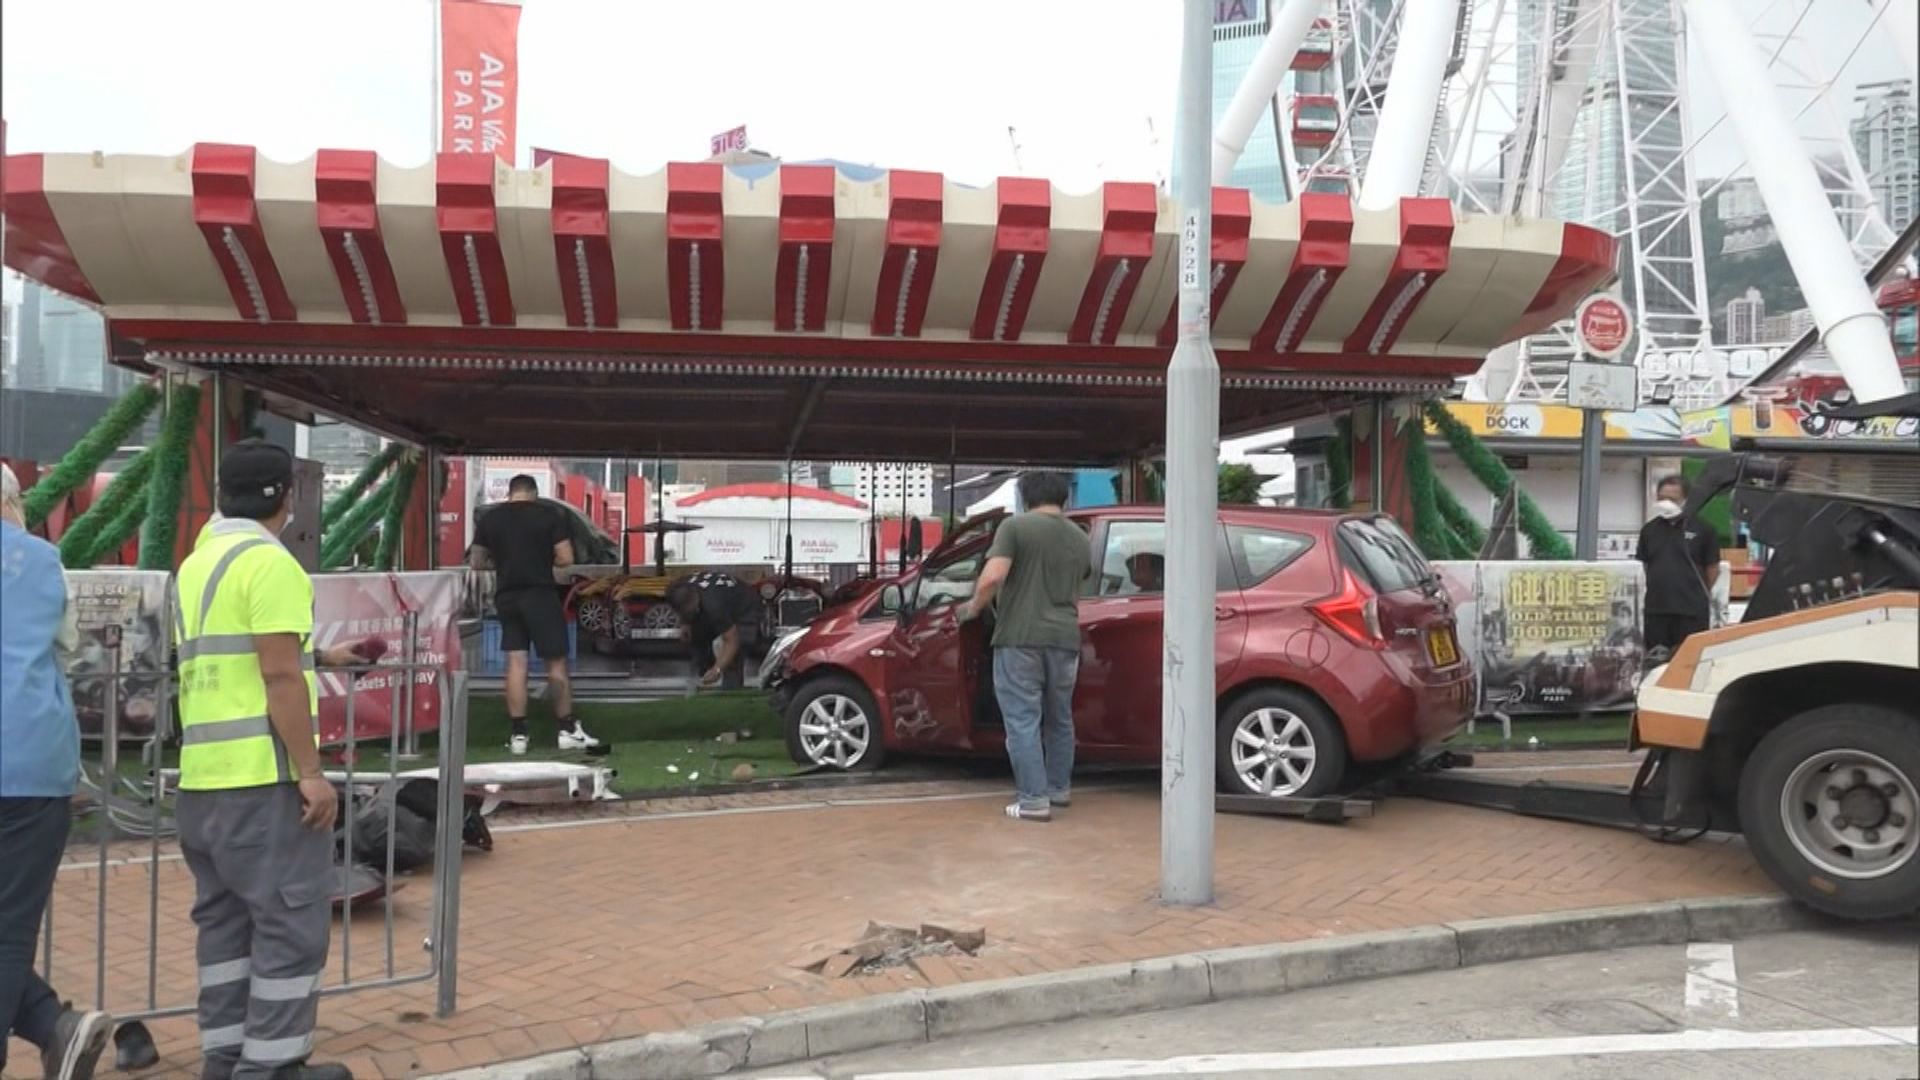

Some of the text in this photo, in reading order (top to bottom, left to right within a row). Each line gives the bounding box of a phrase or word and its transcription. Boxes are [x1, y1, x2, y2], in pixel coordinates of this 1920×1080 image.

[1213, 0, 1249, 23] IA
[453, 69, 474, 153] PARK
[480, 52, 507, 153] AIA Vita
[1486, 416, 1530, 430] DOCK
[1510, 571, 1608, 606] 碰碰車
[1511, 625, 1608, 640] DODGEMS
